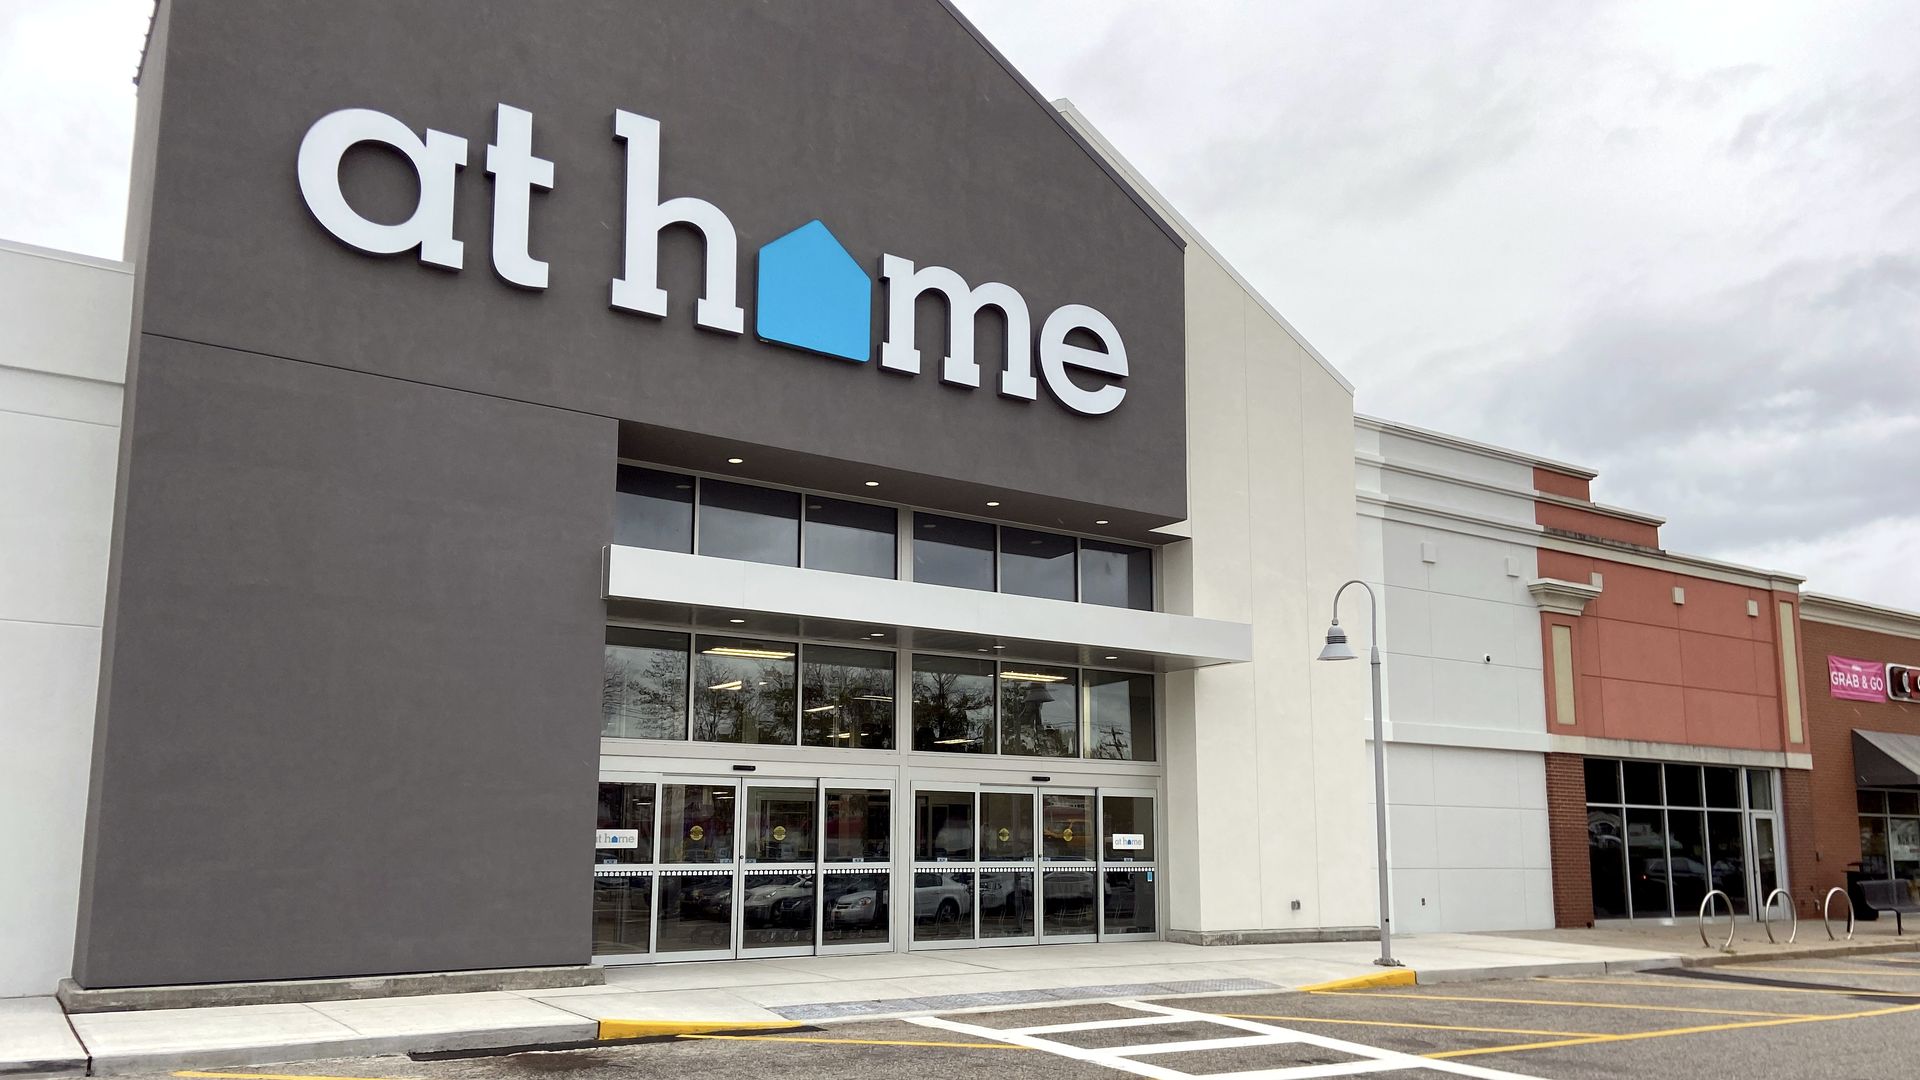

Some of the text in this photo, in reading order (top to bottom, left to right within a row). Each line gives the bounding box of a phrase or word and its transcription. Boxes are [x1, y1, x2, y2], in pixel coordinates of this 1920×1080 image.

[297, 103, 555, 289] at
[1831, 671, 1883, 691] GRAB & GO
